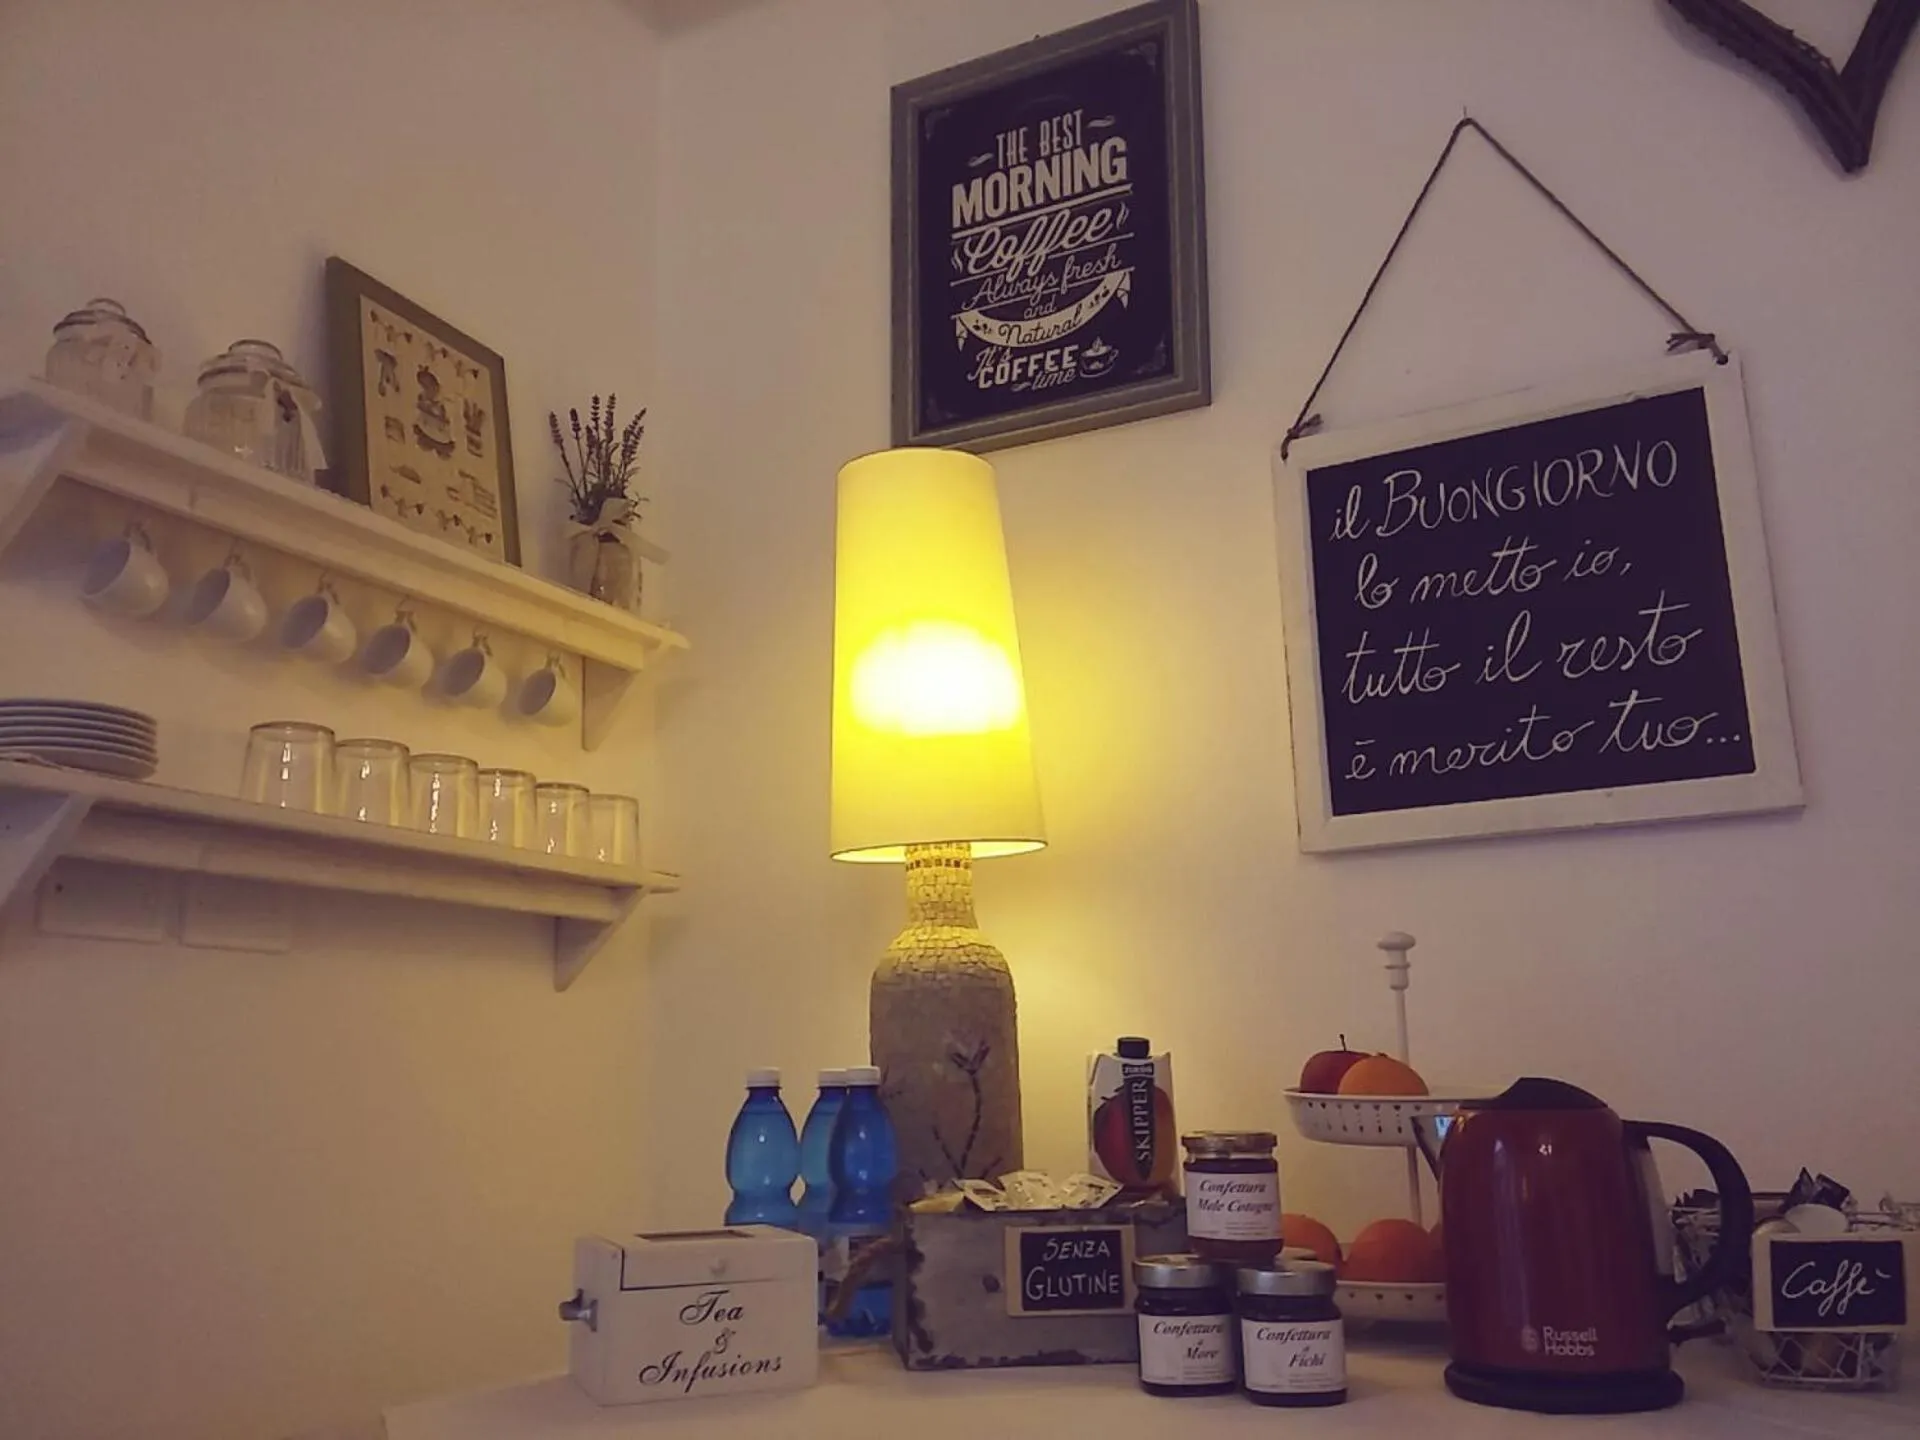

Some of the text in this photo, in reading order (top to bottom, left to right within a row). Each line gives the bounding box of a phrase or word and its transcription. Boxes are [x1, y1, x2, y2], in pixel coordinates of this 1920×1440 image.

[996, 108, 1084, 169] THE BEST
[952, 135, 1127, 229] MORNING
[965, 207, 1112, 281] Coffee
[961, 242, 1122, 311] Always fresh
[998, 306, 1084, 346] Natural
[1023, 295, 1057, 320] and
[978, 344, 1079, 389] COFFEE
[1031, 368, 1076, 391] time
[1329, 439, 1678, 542] il BUONGIORNO
[1355, 535, 1633, 609] lo metto io,
[1341, 590, 1704, 704] tutto il resto
[1389, 704, 1595, 777] merito
[1132, 1080, 1151, 1161] SKIPPER
[1199, 1180, 1267, 1196] Confettura
[1042, 1237, 1110, 1261] SENZA
[1025, 1266, 1120, 1300] GLUTINE
[1781, 1259, 1891, 1317] Caffè
[679, 1289, 744, 1326] Tea
[714, 1327, 736, 1355] &
[1153, 1320, 1224, 1337] Confettura
[1256, 1327, 1332, 1345] Confettura
[1543, 1326, 1598, 1341] Russell
[1544, 1340, 1595, 1356] Hobbs
[638, 1350, 782, 1394] Infusions
[1288, 1353, 1327, 1368] Fichi
